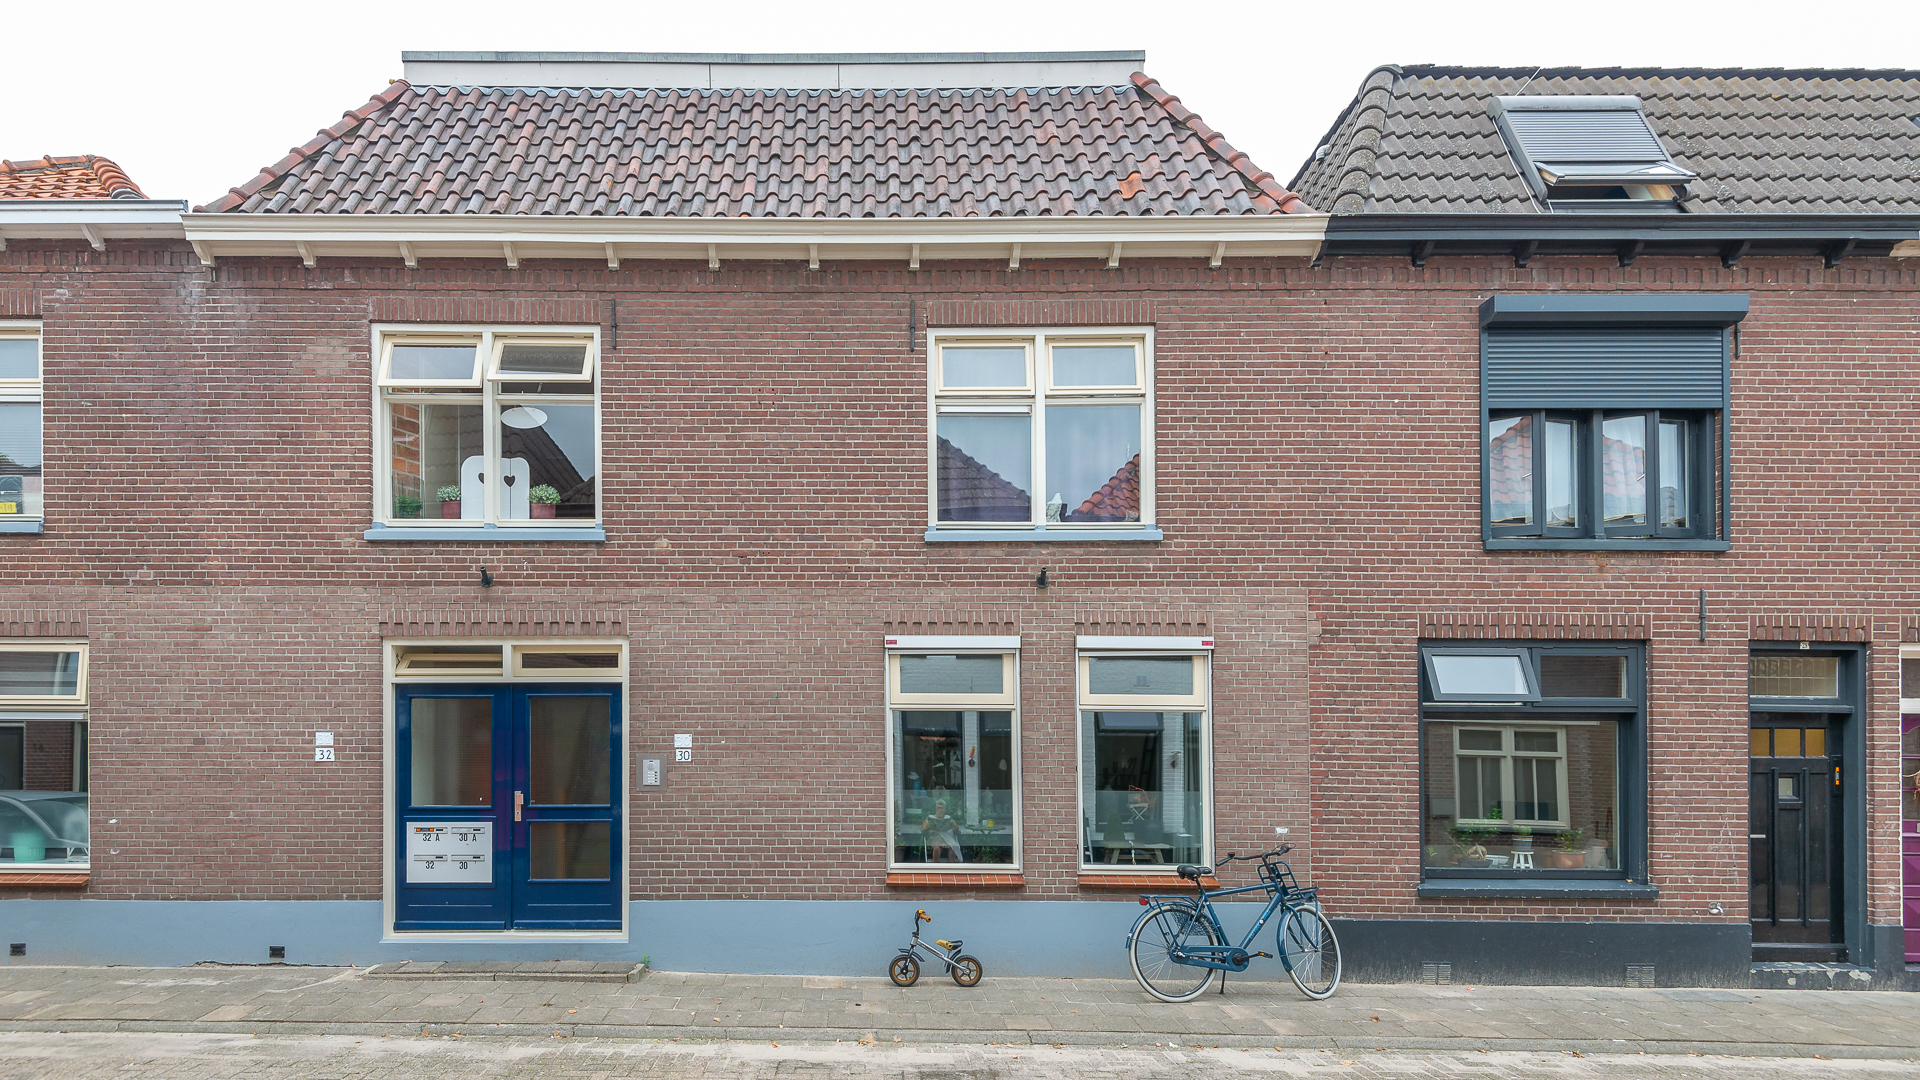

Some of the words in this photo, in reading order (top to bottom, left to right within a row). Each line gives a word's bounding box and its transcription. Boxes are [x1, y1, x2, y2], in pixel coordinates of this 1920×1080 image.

[318, 749, 332, 760] 32
[677, 750, 690, 761] 30
[422, 833, 432, 842] 32
[435, 833, 440, 842] A
[458, 833, 468, 842] 30
[471, 833, 477, 842] A
[425, 860, 435, 870] 32
[459, 861, 468, 870] 30
